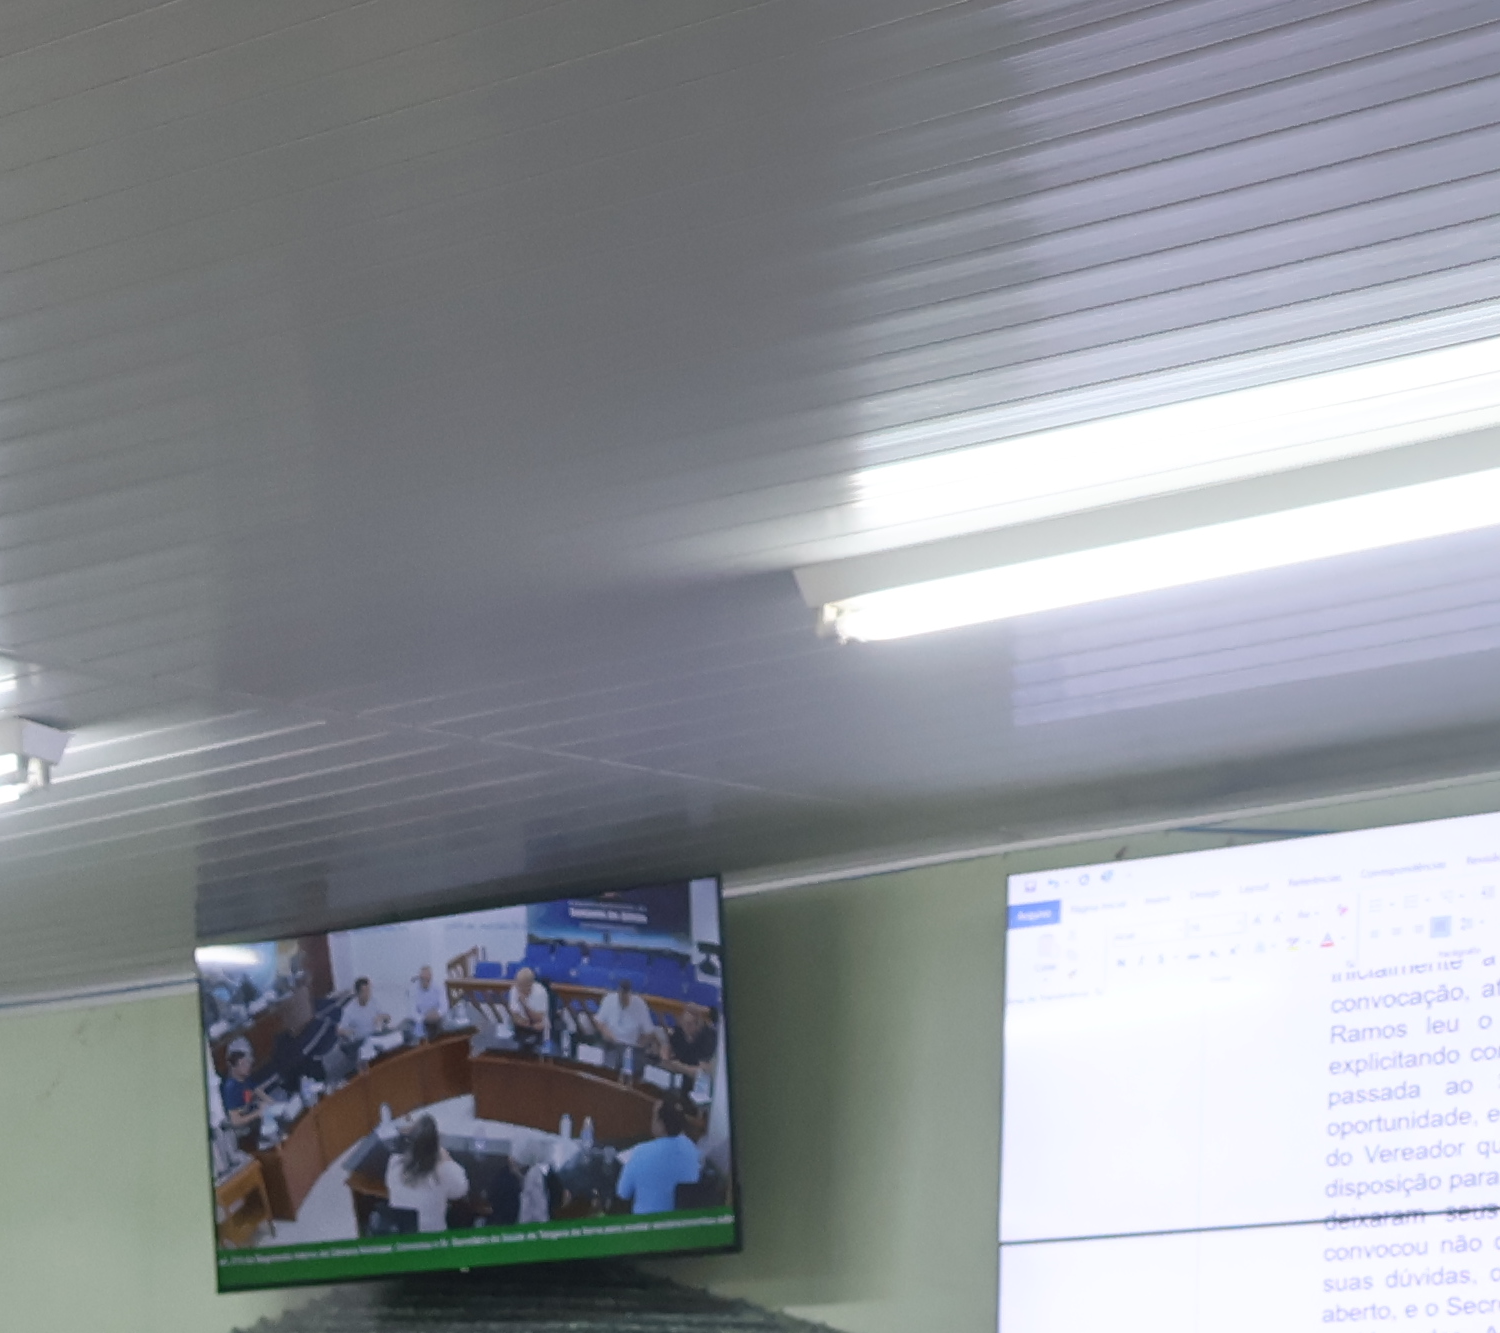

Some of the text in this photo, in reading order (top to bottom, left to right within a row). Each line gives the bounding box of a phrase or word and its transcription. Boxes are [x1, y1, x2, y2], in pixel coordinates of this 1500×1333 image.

[1331, 984, 1470, 1013] convocação,
[1331, 1022, 1408, 1044] Ramos
[1426, 1016, 1460, 1034] leu
[1329, 1046, 1461, 1076] explicitando
[1328, 1079, 1474, 1109] passada ao
[1327, 1108, 1478, 1140] oportunidade,
[1325, 1148, 1353, 1168] do
[1364, 1140, 1466, 1163] Vereador
[1325, 1173, 1442, 1200] disposição
[1323, 1235, 1483, 1262] convocou não
[1323, 1266, 1478, 1293] suas dúvidas,
[1322, 1303, 1397, 1324] aberto,
[1405, 1303, 1418, 1318] e
[1425, 1302, 1439, 1317] o
